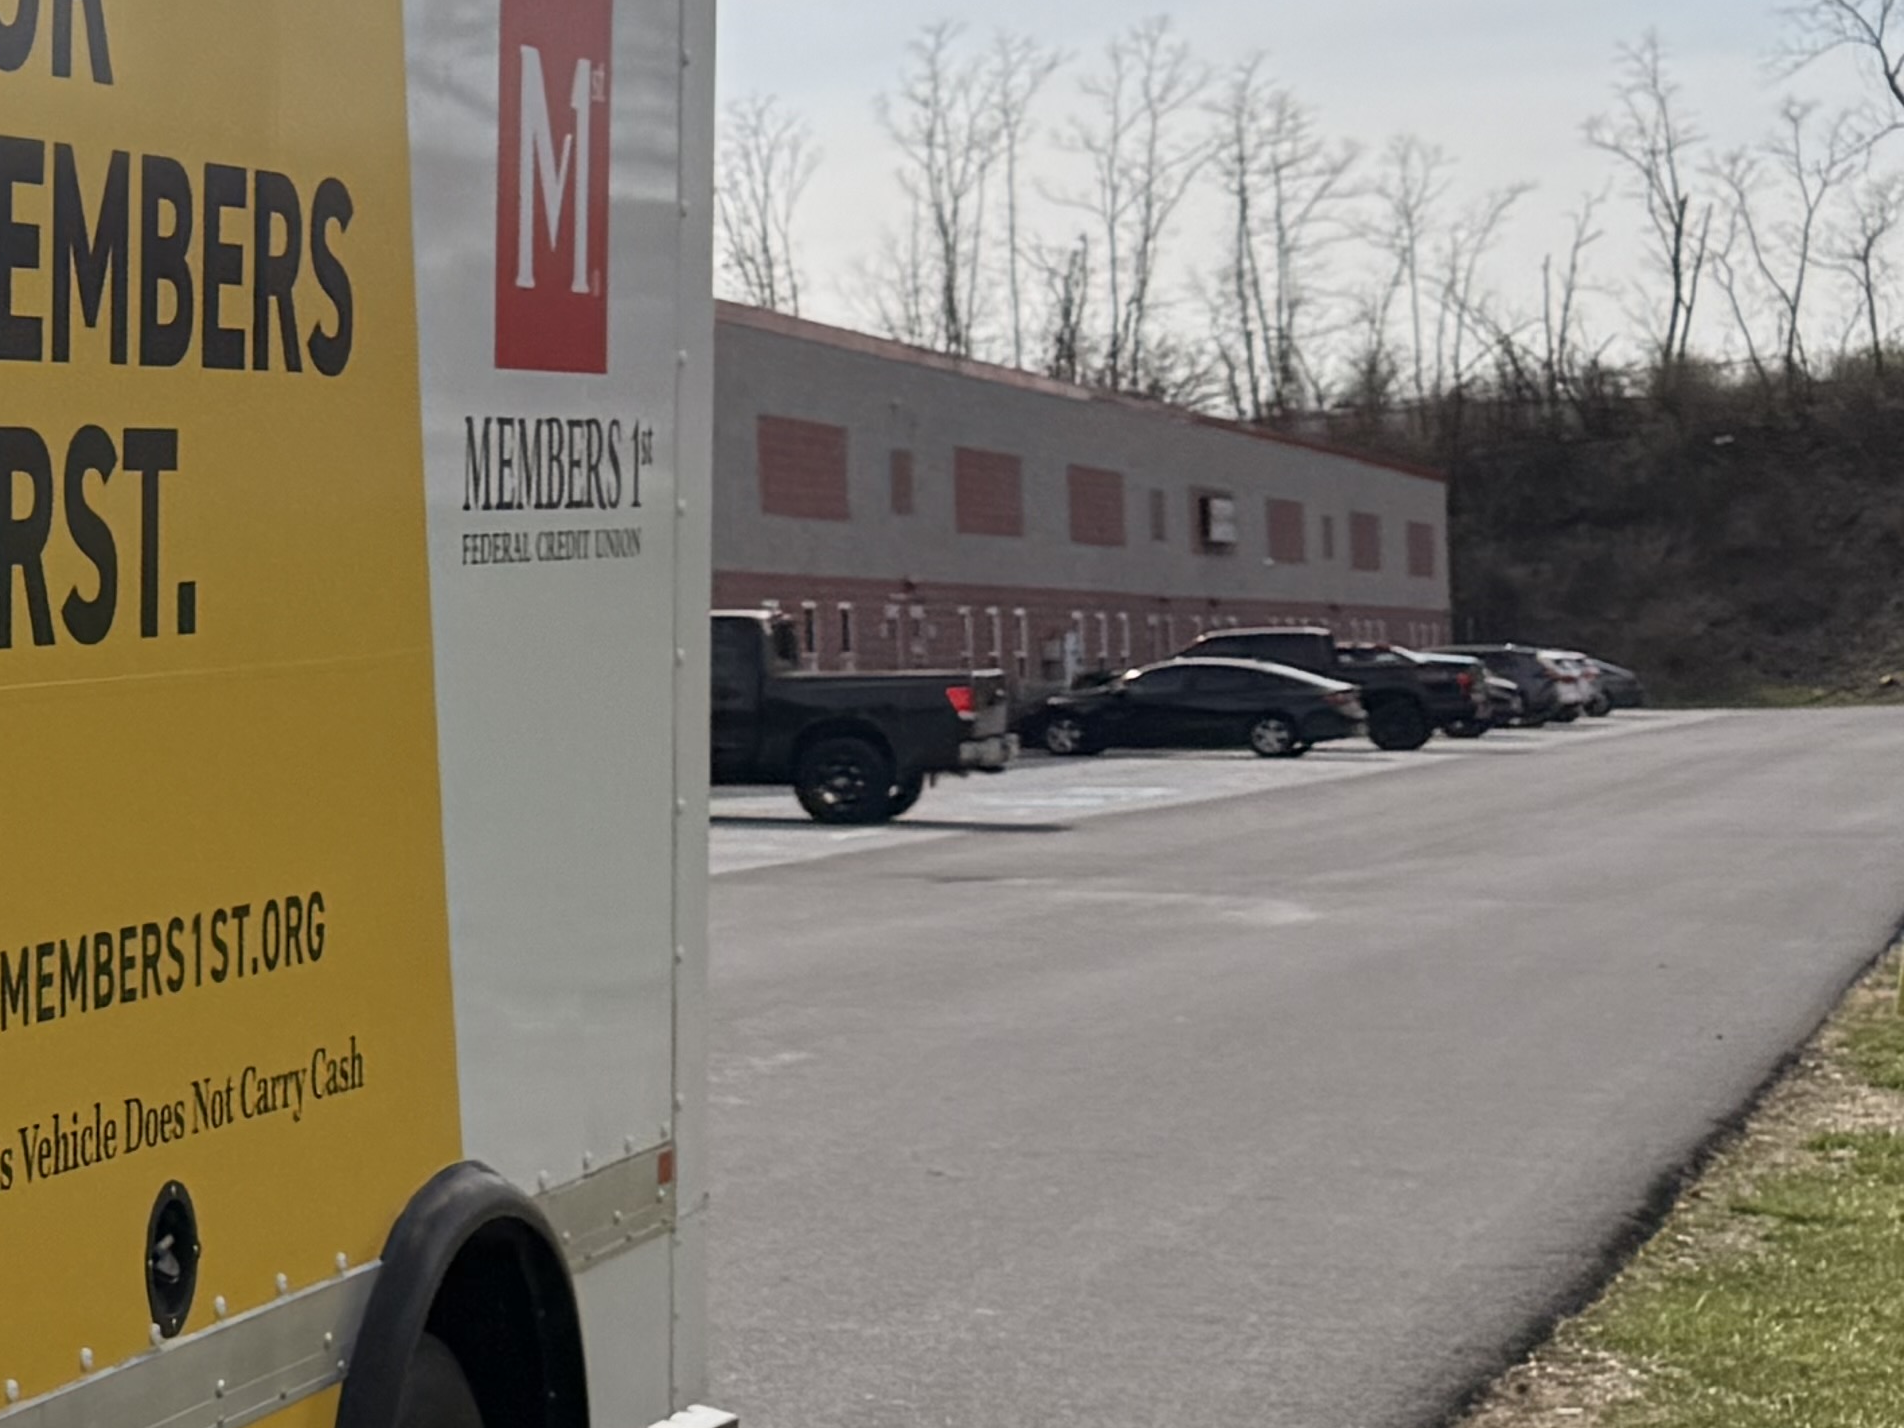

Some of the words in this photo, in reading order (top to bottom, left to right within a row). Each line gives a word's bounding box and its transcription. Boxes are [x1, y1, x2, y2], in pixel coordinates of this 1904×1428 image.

[462, 416, 622, 510] MEMBERS
[462, 531, 532, 565] FEDERAL
[536, 529, 590, 562] CREDIT
[594, 526, 642, 559] UNION
[0, 891, 326, 1032] MEMBERS1ST.ORG
[18, 1102, 117, 1183] Vehicle
[124, 1098, 186, 1156] Does
[191, 1076, 235, 1135] Not
[240, 1065, 308, 1123] Carry
[311, 1035, 365, 1100] Cash
